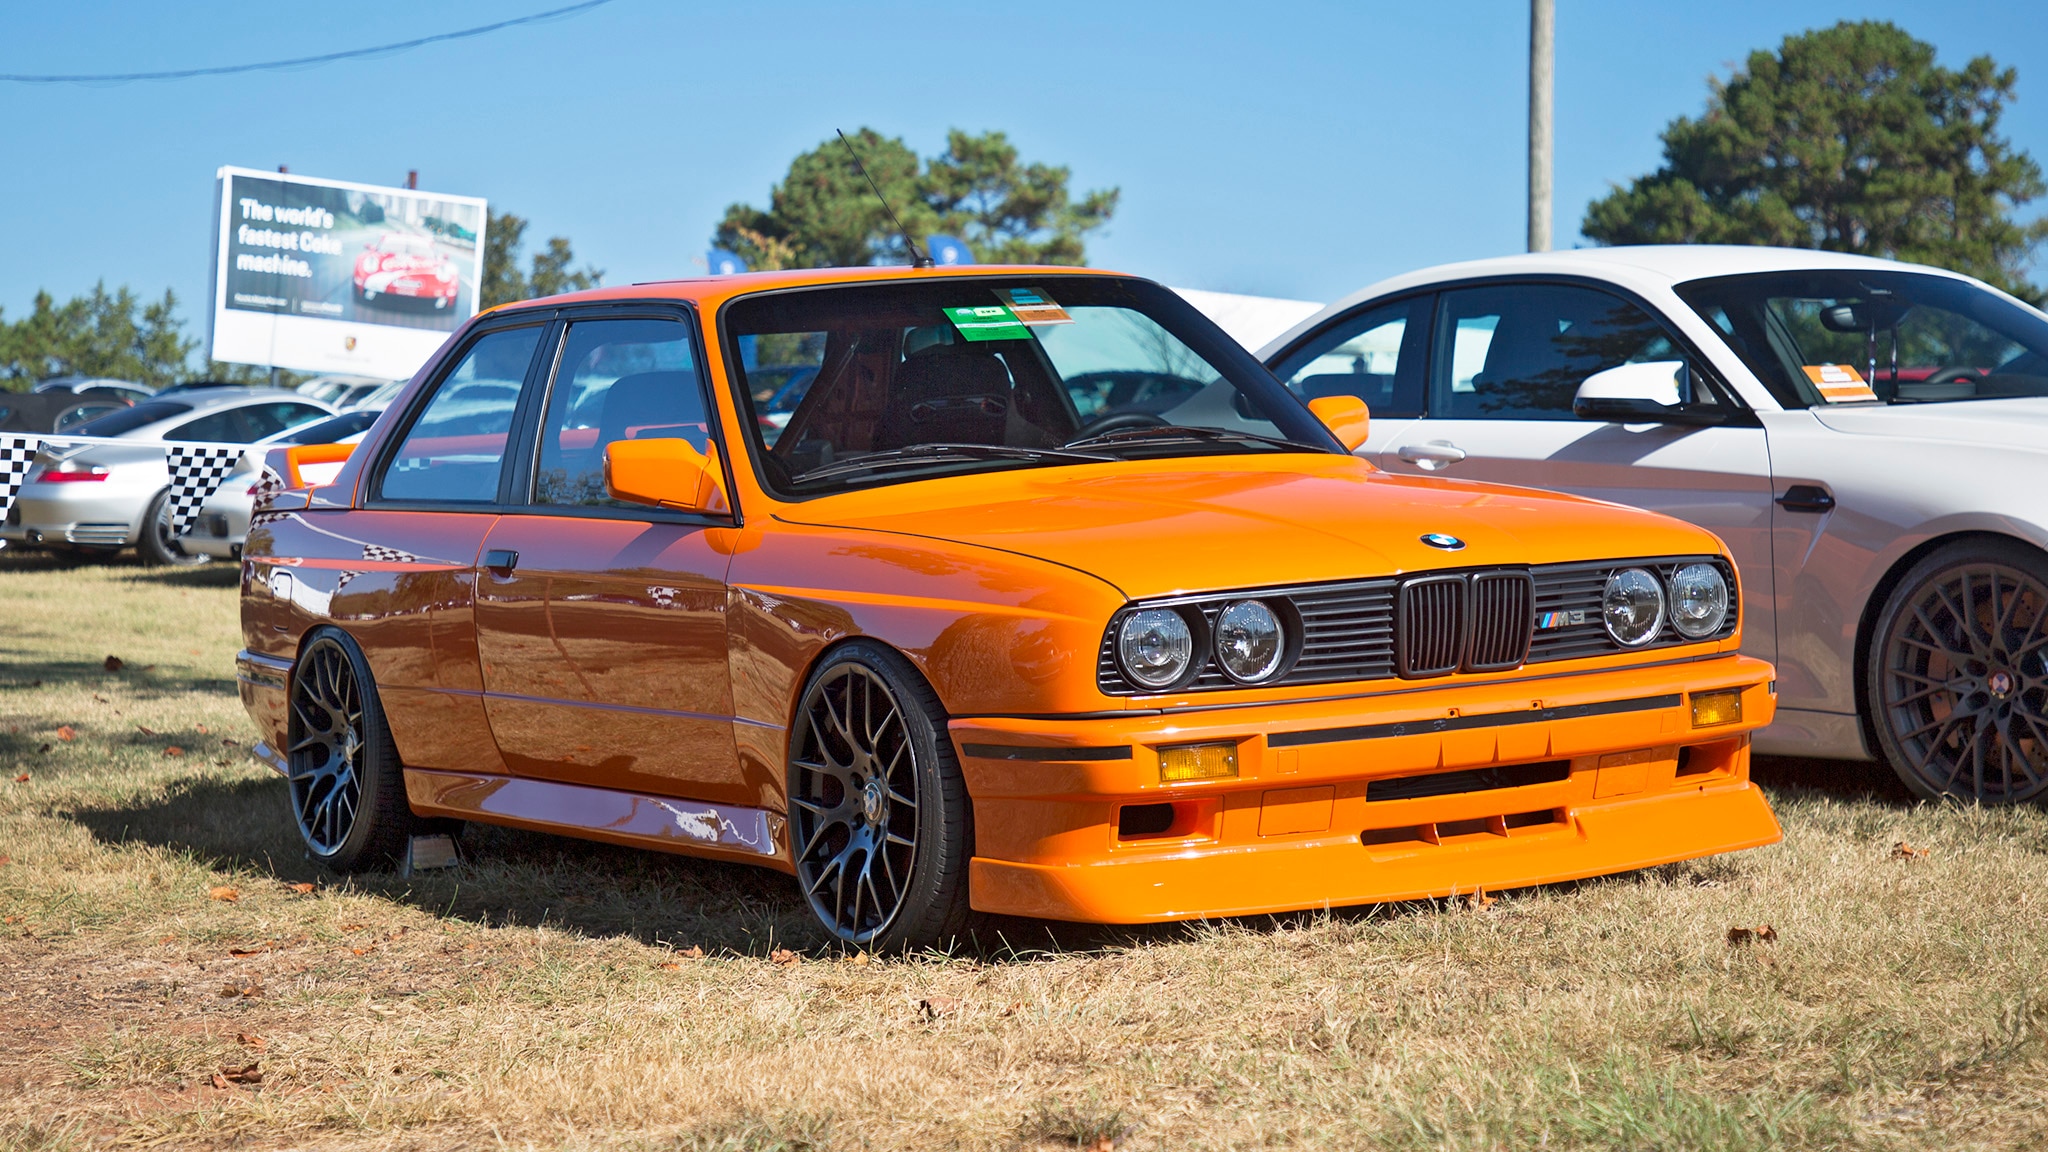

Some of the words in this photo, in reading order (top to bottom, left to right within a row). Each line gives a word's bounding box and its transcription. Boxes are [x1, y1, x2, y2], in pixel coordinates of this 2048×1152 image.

[239, 198, 273, 222] The
[274, 205, 334, 229] world's
[238, 224, 299, 251] fastest
[236, 253, 313, 278] machine.
[1554, 610, 1585, 628] M3
